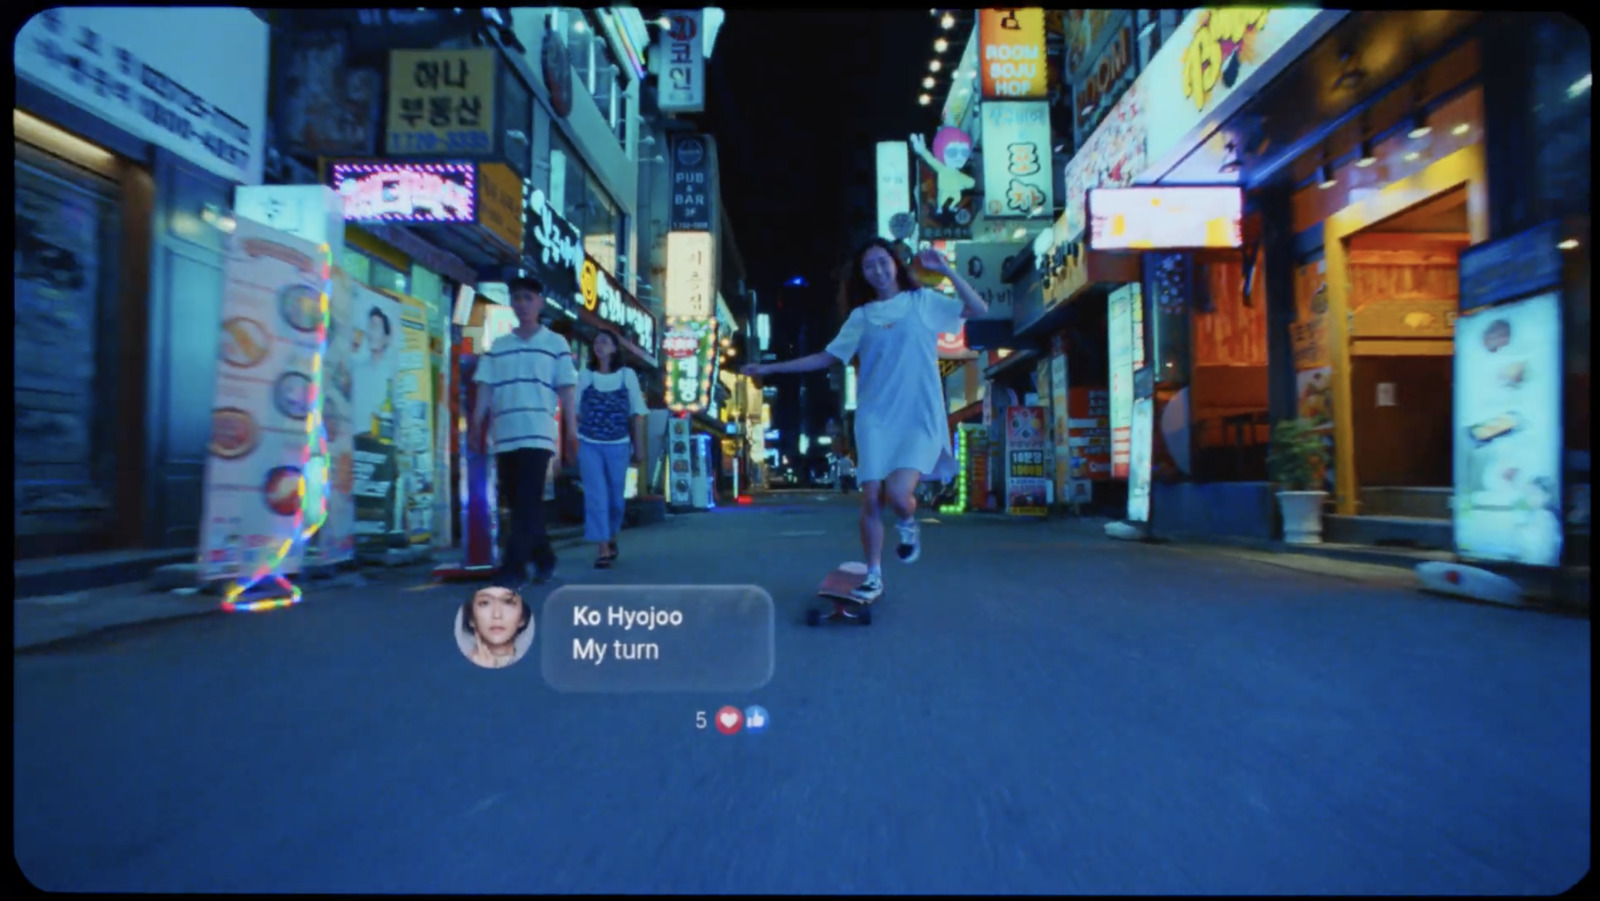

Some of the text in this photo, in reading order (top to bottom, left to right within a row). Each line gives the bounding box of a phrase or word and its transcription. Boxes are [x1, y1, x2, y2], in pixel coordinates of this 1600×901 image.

[986, 45, 1038, 60] ROOM
[413, 58, 470, 91] 하나
[990, 63, 1036, 78] SOJU
[399, 95, 482, 128] 부동산
[676, 173, 703, 183] PUB
[675, 194, 704, 205] BAR
